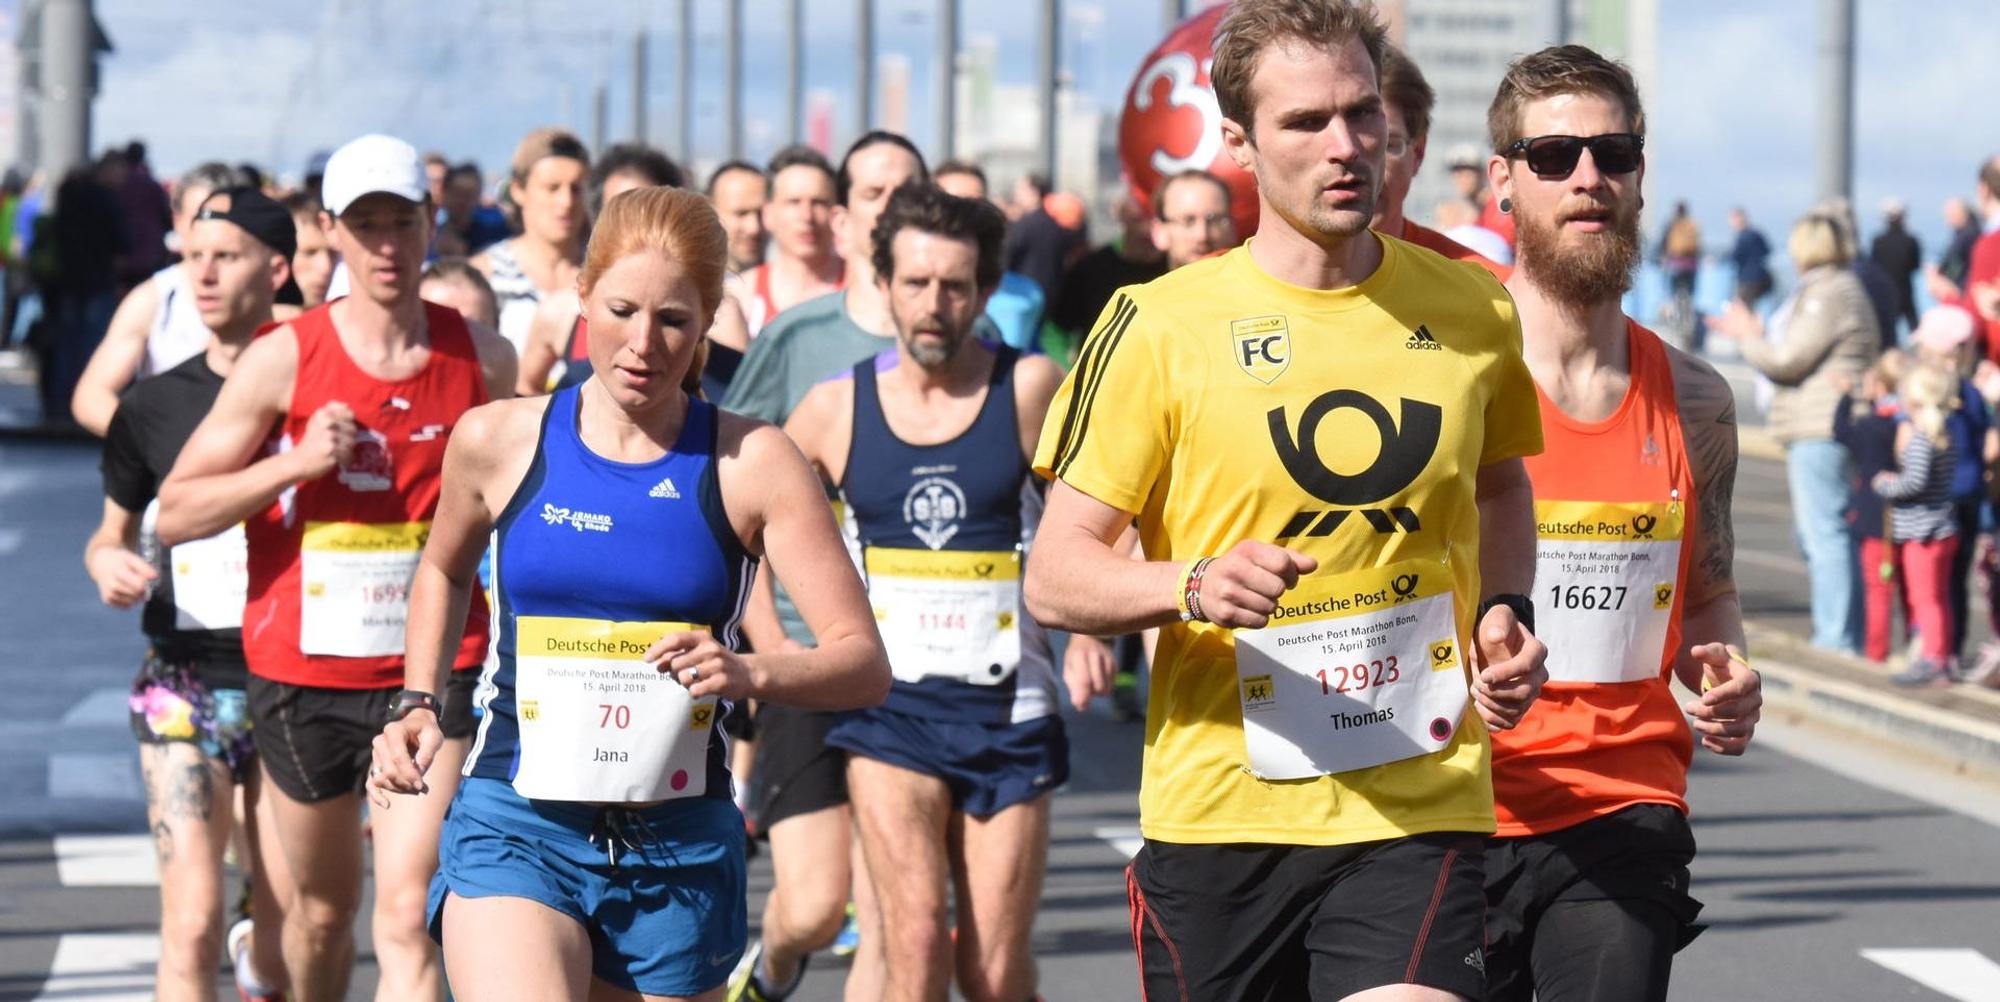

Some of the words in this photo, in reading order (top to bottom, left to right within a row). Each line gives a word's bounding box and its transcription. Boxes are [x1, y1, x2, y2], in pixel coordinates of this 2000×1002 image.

[1242, 335, 1284, 366] FC
[1406, 340, 1442, 351] adidas
[649, 490, 680, 499] adidas
[1538, 521, 1594, 534] eutsche
[1598, 522, 1627, 535] Post
[1568, 551, 1586, 560] Post
[1589, 551, 1629, 561] Marathon
[1576, 563, 1597, 574] April
[1600, 565, 1620, 574] 2018
[1273, 596, 1350, 620] Deutsche
[1354, 588, 1388, 608] Post
[1551, 585, 1627, 611] 16627
[1278, 632, 1324, 647] Deutsche
[1327, 629, 1348, 640] Post
[1351, 620, 1394, 636] Marathon
[1396, 613, 1418, 626] Bonn,
[547, 637, 616, 653] Deutsche
[1322, 645, 1337, 655] 15.
[1339, 640, 1363, 653] April
[1366, 635, 1387, 648] 2018
[589, 670, 609, 679] Post
[612, 670, 657, 681] Marathon
[1316, 655, 1400, 696] 12923
[599, 682, 620, 693] April
[623, 684, 646, 693] 2018
[598, 704, 631, 729] 70
[1330, 706, 1395, 731] Thomas
[593, 747, 629, 763] Jana
